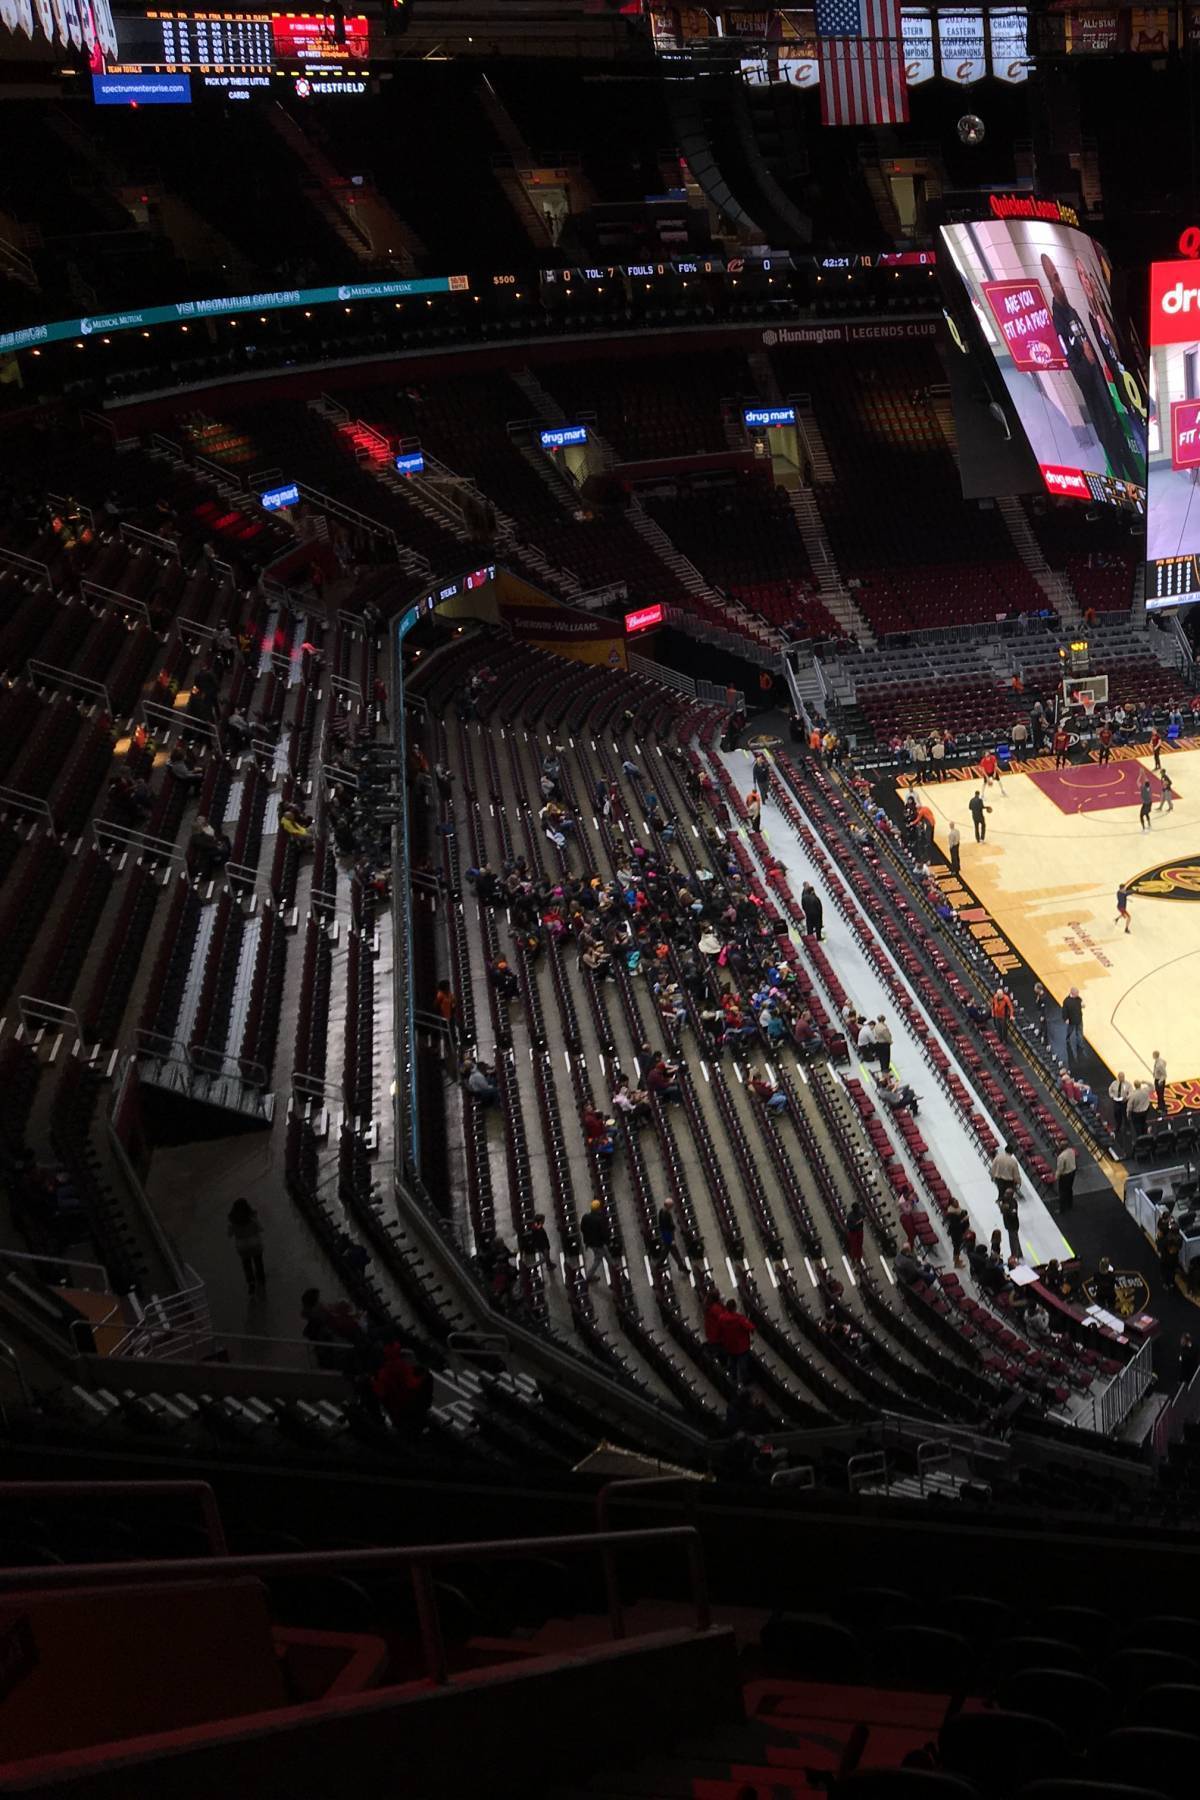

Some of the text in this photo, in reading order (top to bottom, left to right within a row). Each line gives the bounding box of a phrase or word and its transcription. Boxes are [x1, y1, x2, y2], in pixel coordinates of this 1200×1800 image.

[947, 27, 976, 35] EASTERN
[205, 78, 270, 86] PICK UP THESE LITTLE
[312, 83, 364, 93] WESTFIELD
[102, 84, 184, 93] spectrumenterprise.com
[228, 91, 249, 99] CARDS
[822, 256, 872, 268] 42:21 1Q
[919, 253, 926, 264] 0
[628, 264, 664, 276] FOULS 0
[678, 262, 712, 273] FG% 0
[763, 260, 770, 271] 0
[563, 271, 571, 281] 0
[608, 267, 614, 278] 7
[493, 275, 515, 285] $500
[351, 283, 412, 296] MEDICAL MUTUAL
[1004, 289, 1035, 314] ARE YOU
[779, 327, 841, 343] Huntington
[853, 324, 937, 338] LEGENDS CLUB
[746, 409, 795, 423] drug mart
[541, 429, 587, 444] drug mart
[1179, 429, 1195, 446] FIT
[1046, 470, 1086, 488] drug mart
[262, 486, 298, 507] drug mart
[514, 618, 598, 632] SHERWIN-WILLIAMS
